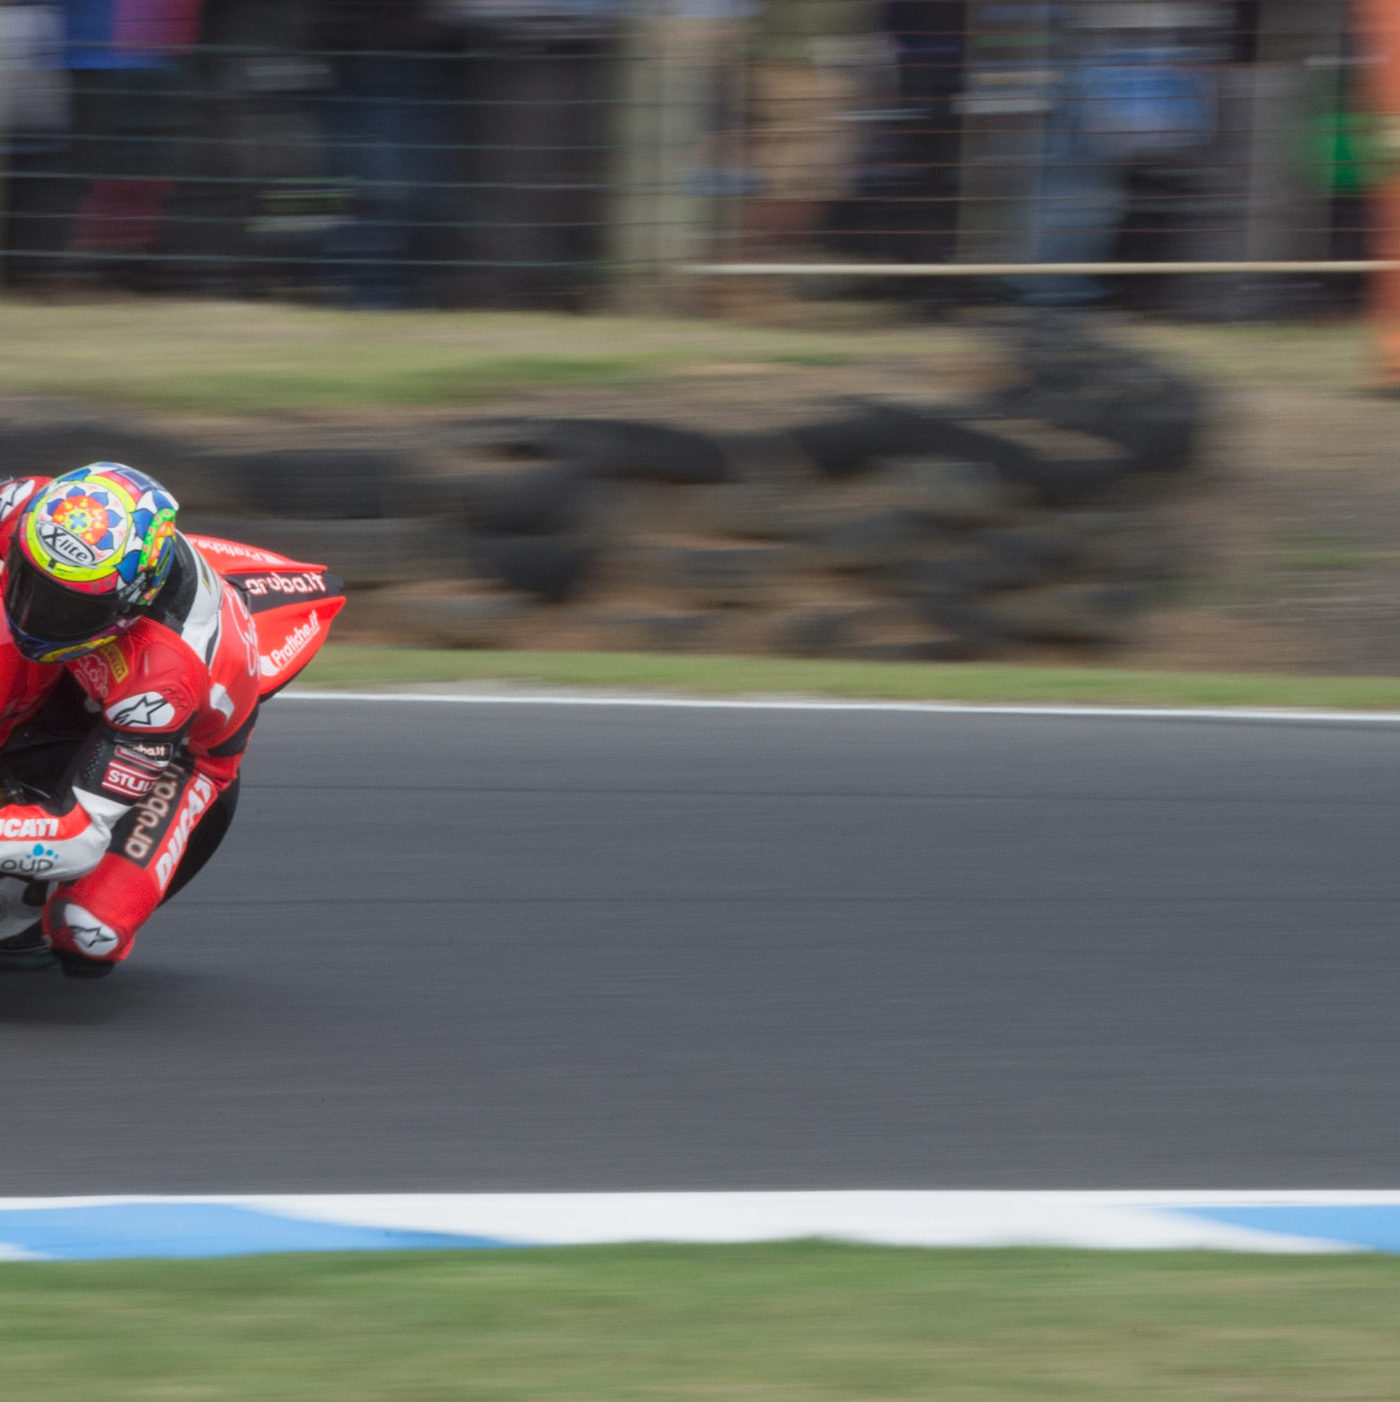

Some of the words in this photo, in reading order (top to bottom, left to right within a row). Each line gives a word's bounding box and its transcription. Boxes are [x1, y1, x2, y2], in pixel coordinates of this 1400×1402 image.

[42, 527, 88, 563] X-lite
[245, 571, 326, 594] aruba.it
[270, 610, 320, 667] Pratiche.it
[155, 773, 214, 891] DUCATI
